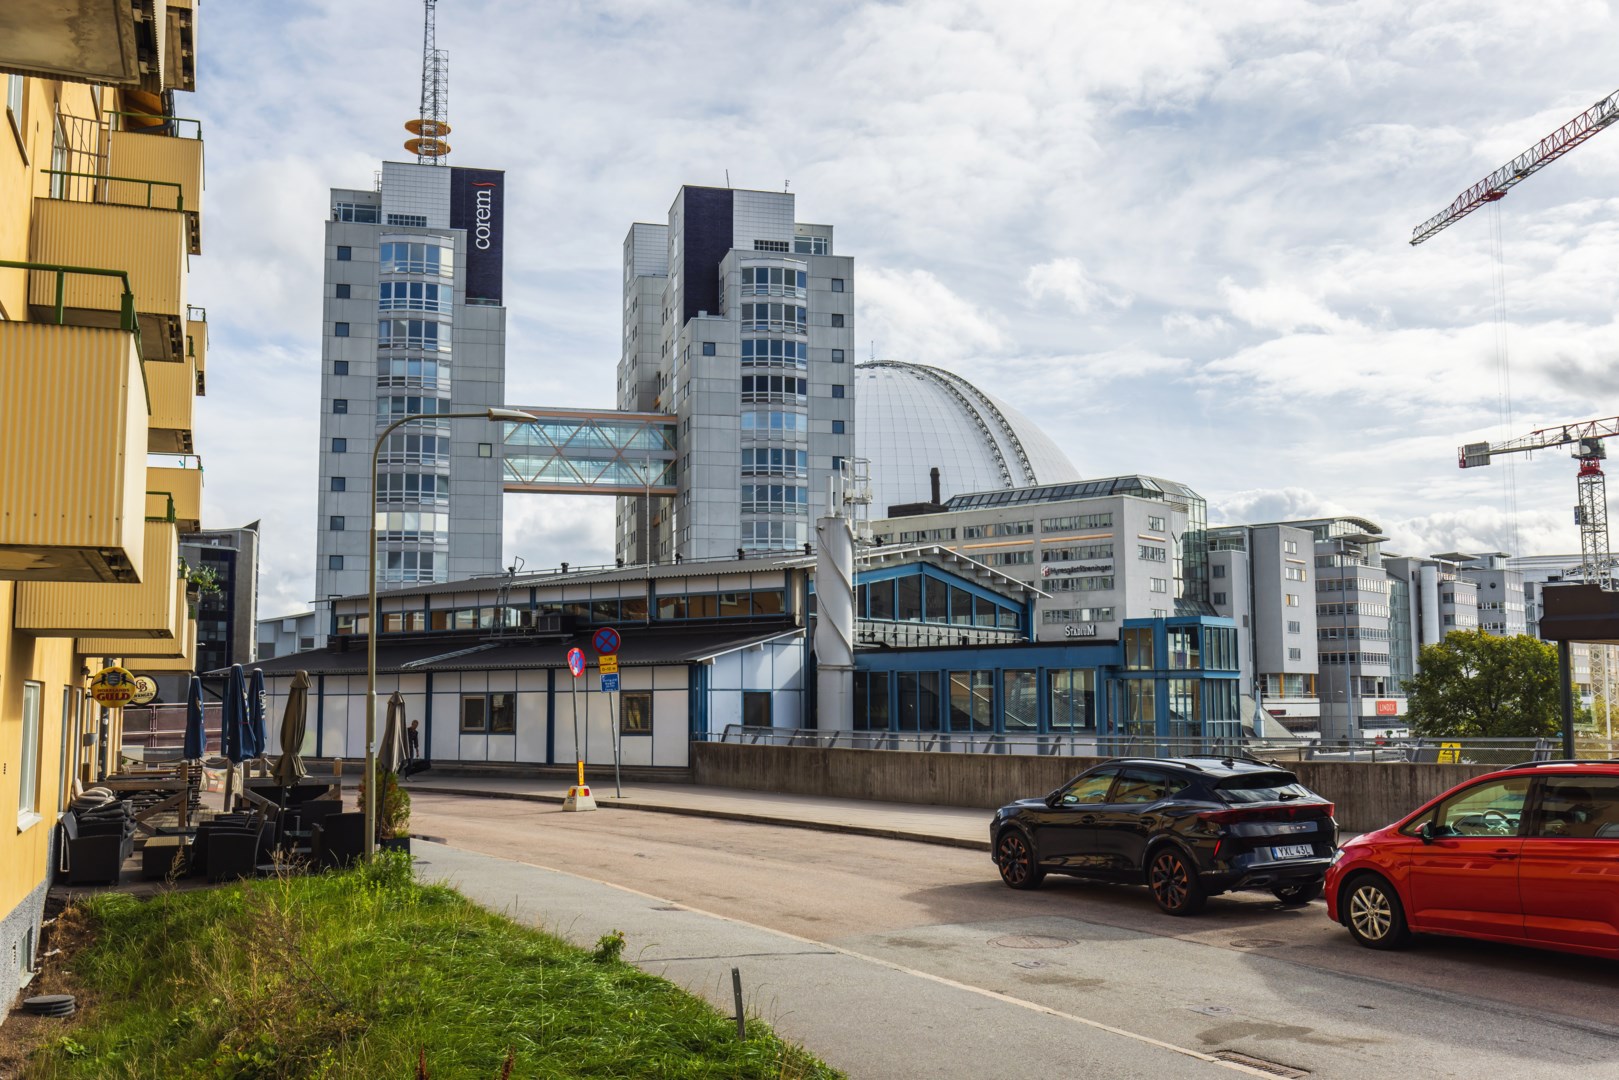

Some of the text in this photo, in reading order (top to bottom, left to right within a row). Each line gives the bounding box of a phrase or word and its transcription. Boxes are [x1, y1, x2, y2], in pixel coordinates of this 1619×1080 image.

[475, 189, 491, 250] corem
[96, 692, 130, 701] GULD
[1277, 844, 1311, 857] YXL 43L
